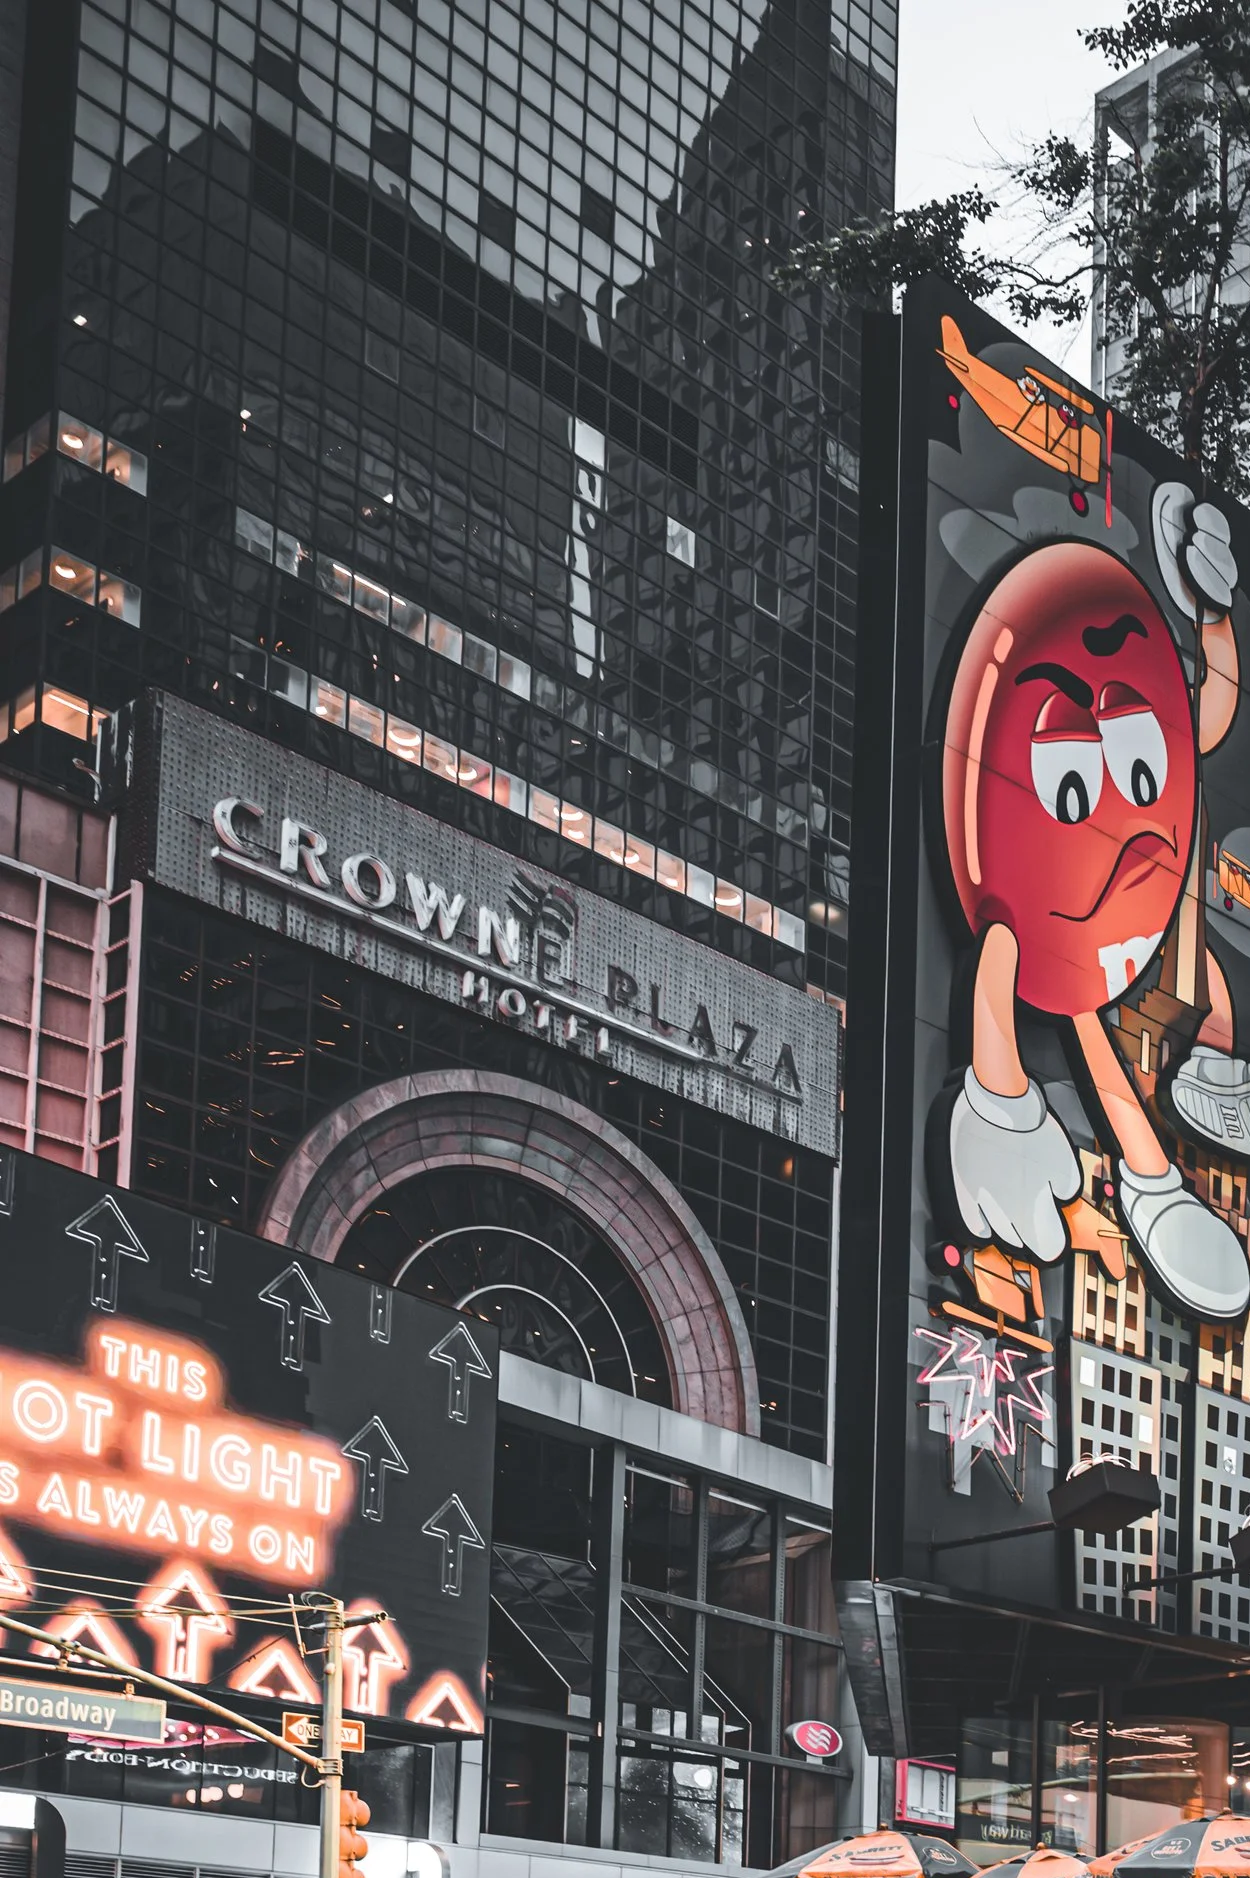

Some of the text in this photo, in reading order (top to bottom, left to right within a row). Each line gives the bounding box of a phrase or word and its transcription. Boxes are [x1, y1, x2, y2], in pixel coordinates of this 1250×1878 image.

[213, 796, 802, 1093] CROWNE PLAZA
[462, 970, 613, 1057] HOTEL
[101, 1335, 207, 1401] THIS
[0, 1370, 341, 1515] OT LIGHT
[38, 1474, 233, 1554] ALWAYS
[249, 1525, 314, 1574] ON
[0, 1689, 116, 1731] Broadway
[297, 1724, 320, 1738] ONE
